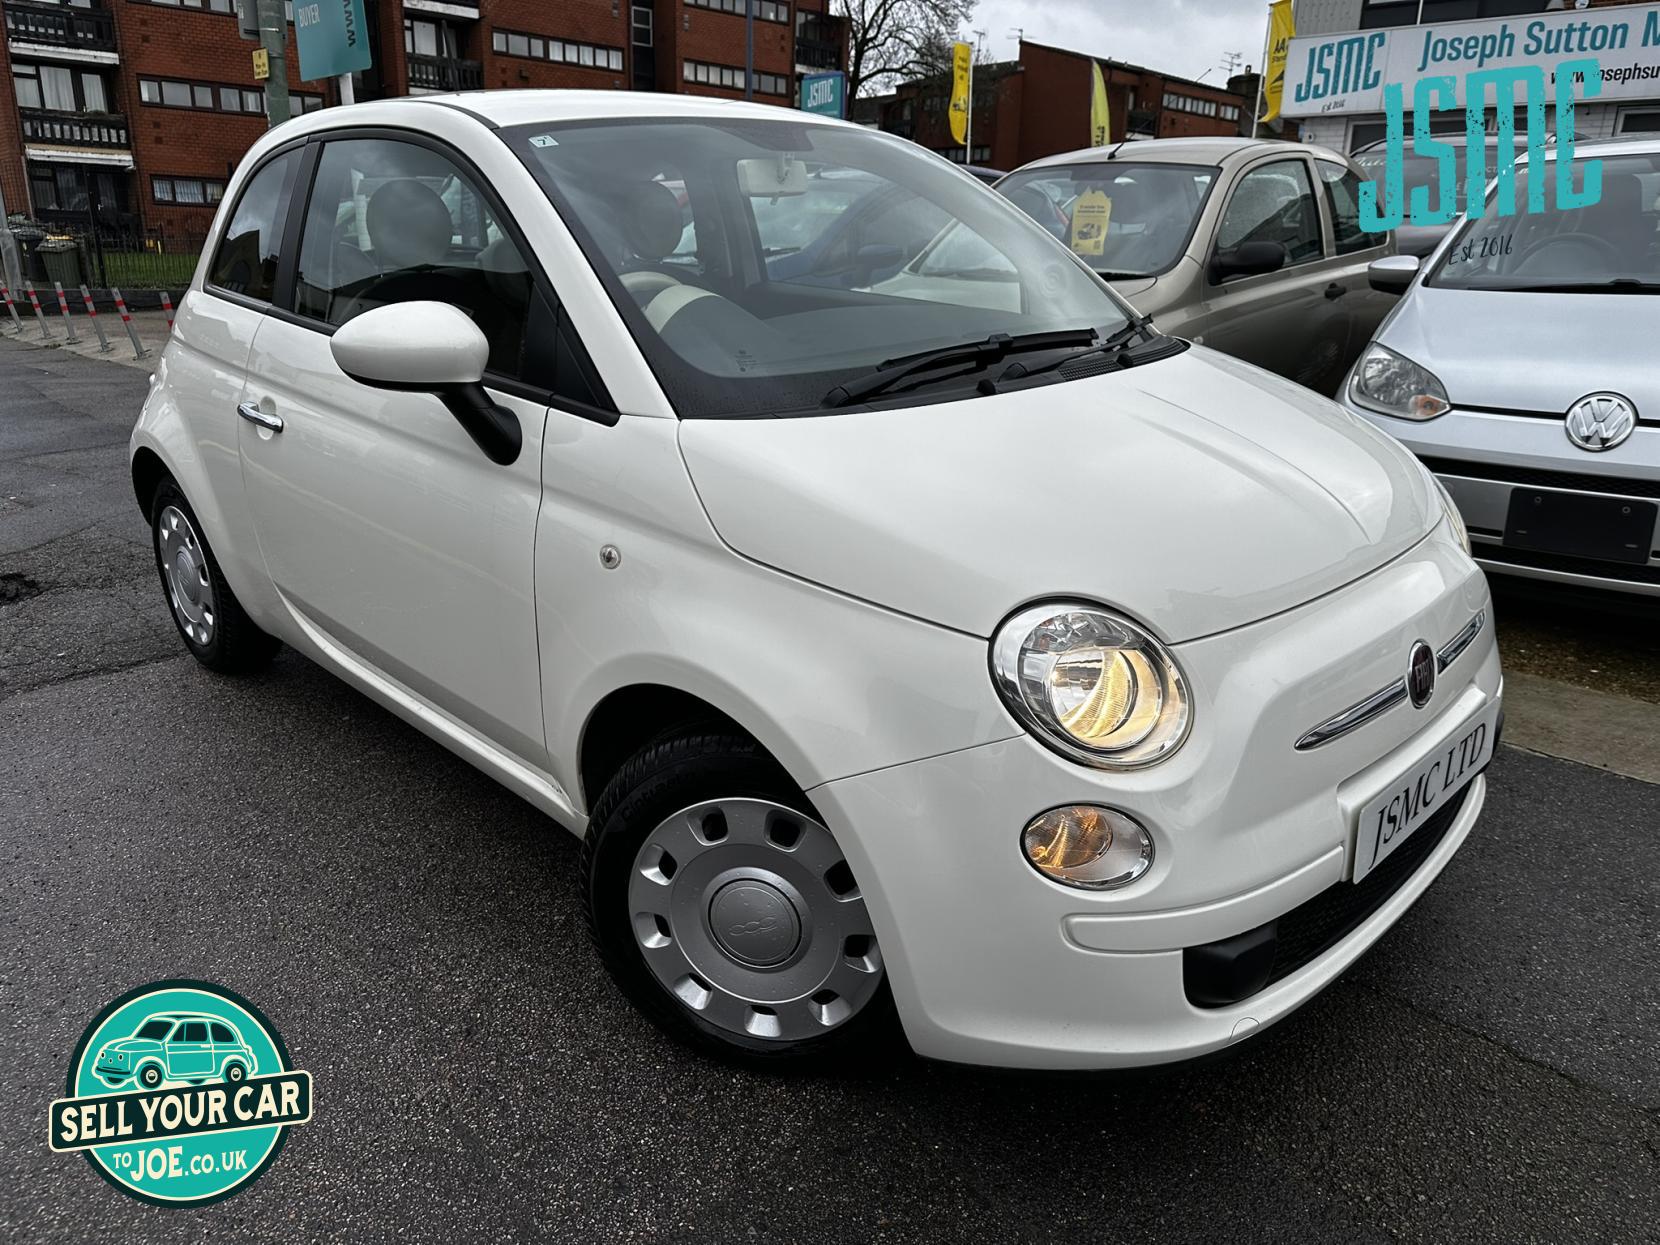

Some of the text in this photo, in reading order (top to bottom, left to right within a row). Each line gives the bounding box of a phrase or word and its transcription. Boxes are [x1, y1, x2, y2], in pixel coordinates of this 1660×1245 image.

[299, 3, 320, 27] BUYER
[1294, 32, 1385, 103] JSMC
[1417, 24, 1515, 72] Joseph
[1523, 21, 1629, 56] Sutton
[807, 79, 834, 108] JSMC
[1368, 722, 1486, 870] JSMC LTD
